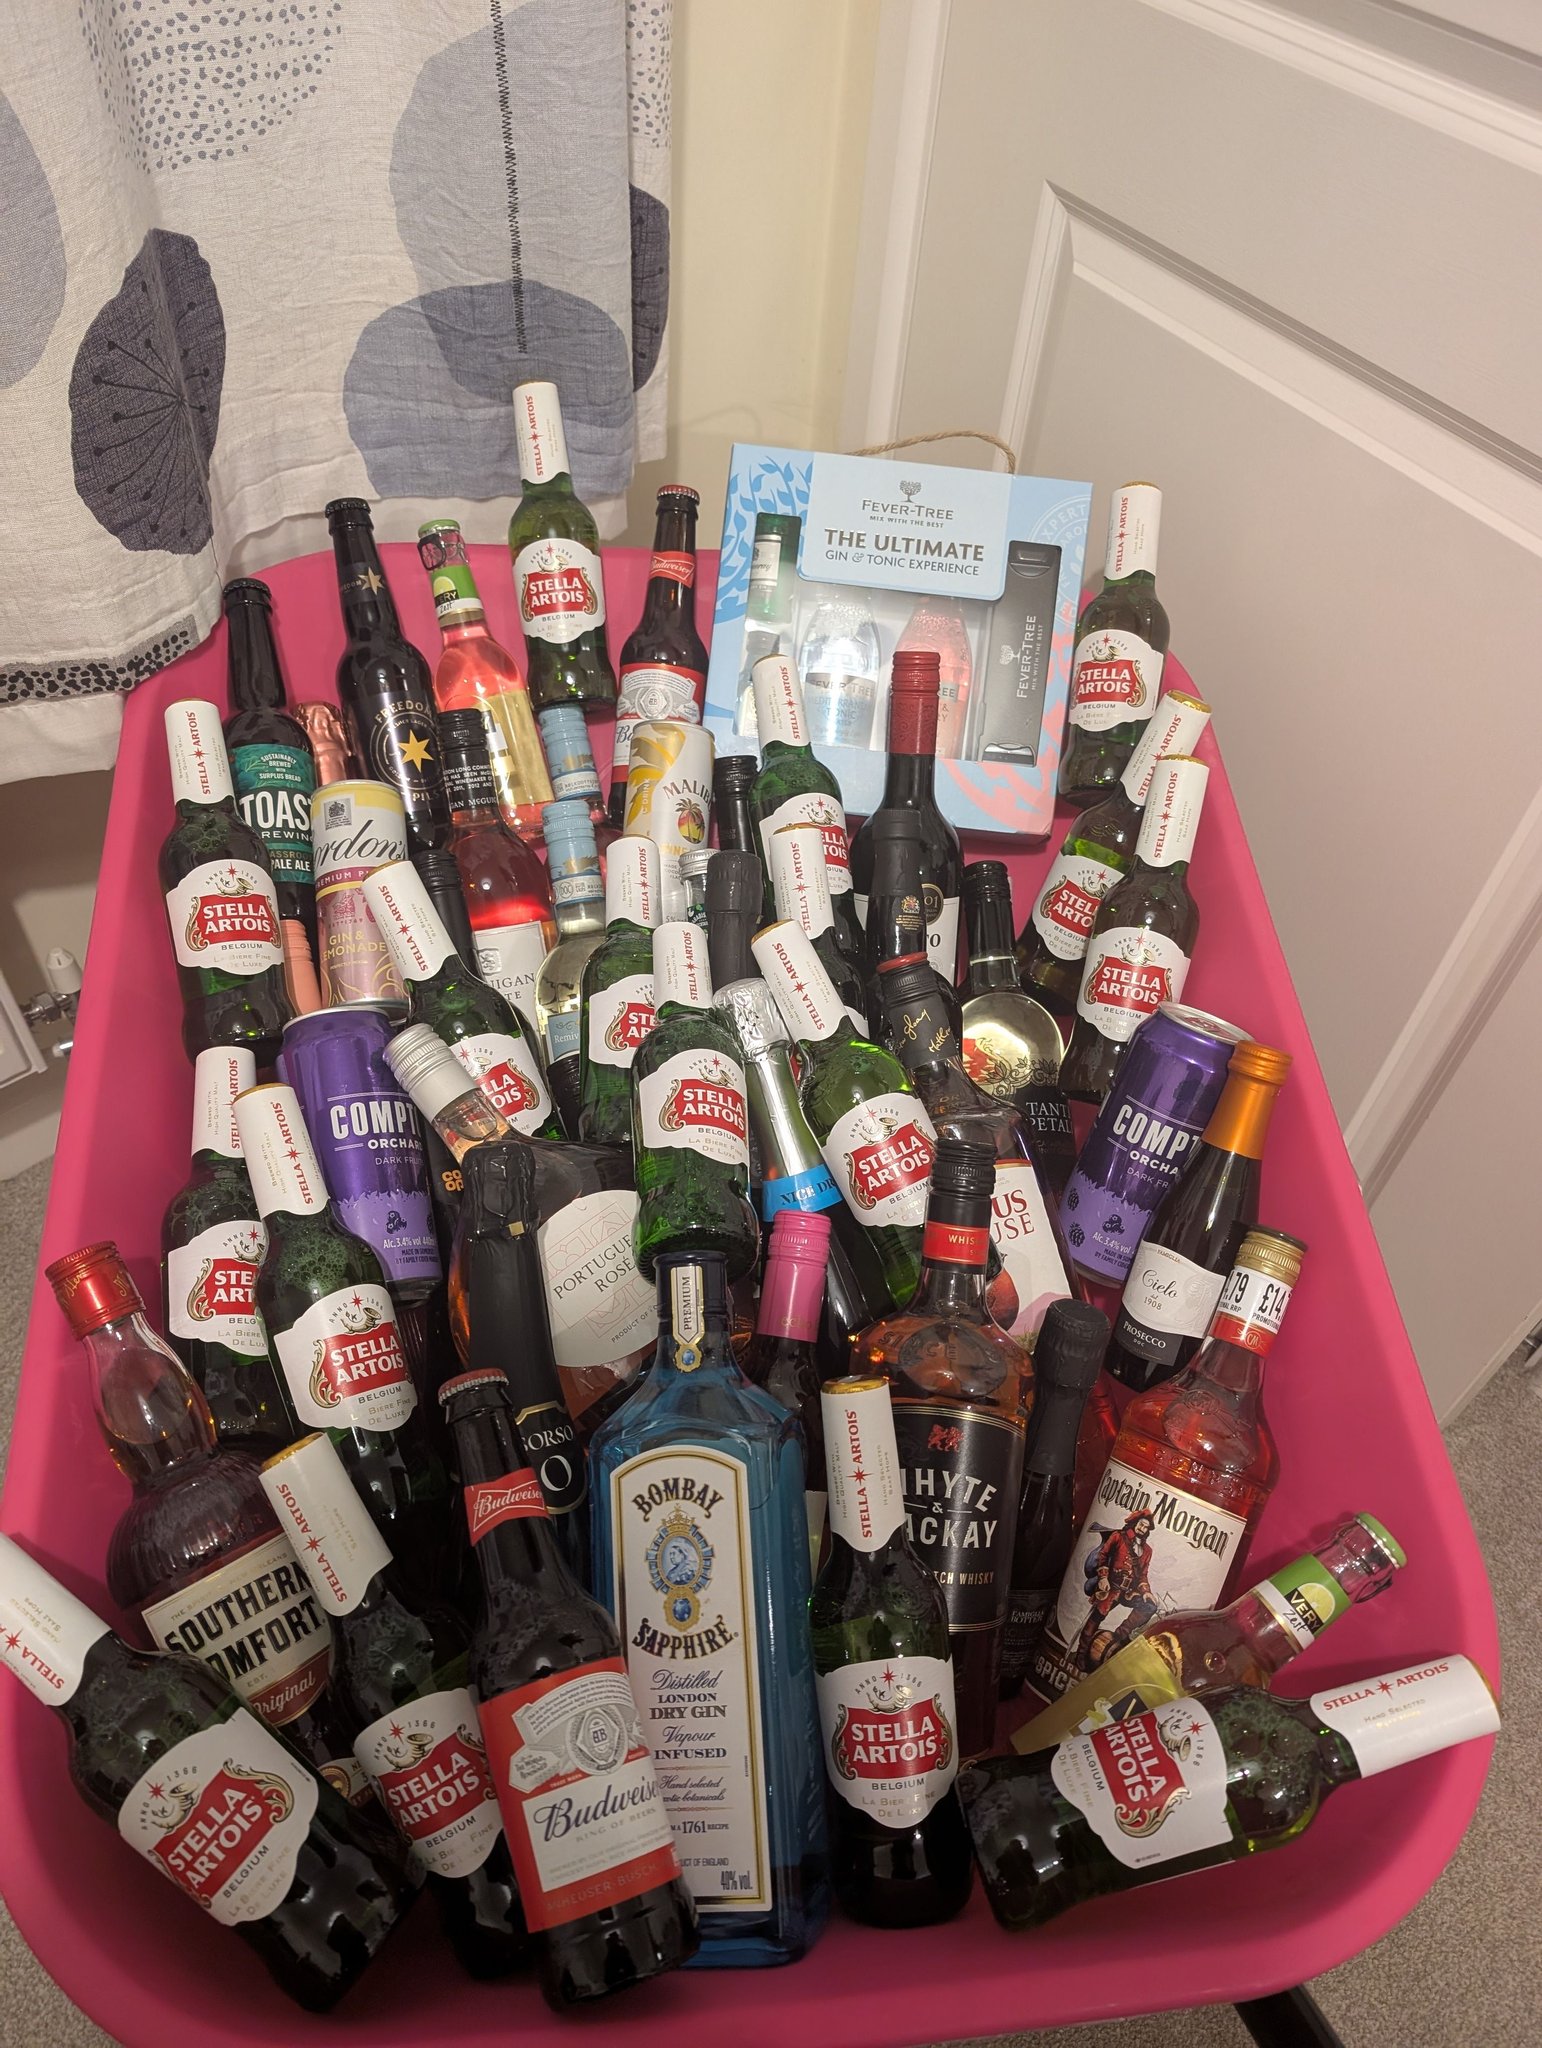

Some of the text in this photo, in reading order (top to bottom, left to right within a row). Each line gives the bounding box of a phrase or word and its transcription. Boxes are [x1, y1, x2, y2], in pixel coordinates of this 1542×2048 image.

[526, 395, 544, 476] STELLA ARTOIS
[862, 499, 954, 521] FEVER-TREE
[887, 518, 907, 526] WITH
[909, 520, 924, 528] THE
[926, 521, 944, 529] BEST
[1115, 497, 1128, 572] STELLA ARTOIS
[824, 528, 985, 562] THE ULTIMATE
[825, 549, 979, 576] GIN & TONIC EXPERIENCE
[529, 578, 582, 595] STELLA
[530, 590, 585, 609] ARTOIS
[541, 613, 576, 622] BELGIUM
[1016, 615, 1037, 698] FEVER-TREE
[1077, 682, 1132, 696] ARTOIS
[1079, 669, 1131, 683] STELLA
[781, 665, 801, 740] STELLA ARTOIS
[1160, 714, 1183, 753] ARTOIS
[189, 710, 211, 796] STELLA ARTOIS
[261, 754, 297, 764] SUSTAINABLY
[268, 760, 292, 768] BREWED
[285, 774, 302, 782] BREAD
[1153, 770, 1179, 859] STELLA ARTOIS
[295, 861, 311, 872] ALE
[640, 847, 651, 921] STELLA ARTOIS
[792, 841, 812, 932] STELLA ARTOIS
[203, 903, 269, 920] STELLA
[196, 917, 272, 934] ARTOIS
[329, 930, 364, 945] GIN &
[379, 883, 428, 972] STELLA ARTOIS
[1053, 924, 1087, 944] BELGIUM
[221, 943, 263, 951] BELGIUM
[682, 930, 699, 1001] STELLA ARTOIS
[1101, 966, 1162, 990] STELLA
[772, 942, 826, 1031] STELLA ARTOIS
[1097, 983, 1161, 1005] ARTOIS
[1103, 1006, 1142, 1020] BELGIUM
[229, 1058, 240, 1097] ARTOIS
[682, 1088, 745, 1113] STELLA
[682, 1102, 745, 1131] ARTOIS
[697, 1127, 739, 1143] BELGIUM
[271, 1101, 314, 1205] STELLA ARTOIS
[375, 1157, 402, 1165] DARK
[858, 1135, 925, 1175] STELLA
[866, 1152, 932, 1192] ARTOIS
[1126, 1167, 1153, 1184] DARK
[888, 1180, 931, 1205] BELGIUM
[383, 1237, 422, 1249] Alc. 3.4% vol
[1103, 1236, 1120, 1251] 3.4%
[1120, 1245, 1131, 1255] vol
[594, 1256, 636, 1293] ROSÉ
[1141, 1269, 1178, 1299] Cielo
[682, 1275, 692, 1332] PREMIUM
[1143, 1297, 1162, 1311] 1908
[1229, 1305, 1242, 1313] RRP
[610, 1309, 651, 1344] PRODUCT OF
[1123, 1321, 1166, 1349] PROSECCO
[330, 1336, 400, 1367] STELLA
[335, 1354, 405, 1386] ARTOIS
[357, 1385, 402, 1406] BELGIUM
[846, 1409, 873, 1539] STELLA ARTOIS
[630, 1476, 725, 1524] BOMBAY
[932, 1502, 944, 1514] &
[1150, 1490, 1231, 1560] Morgan
[276, 1482, 349, 1603] STELLA ARTOIS
[959, 1571, 995, 1585] WHISKY
[1283, 1610, 1308, 1632] Zest
[1290, 1593, 1321, 1628] VERY
[631, 1614, 734, 1661] SAPPHIRE
[21, 1646, 65, 1689] STELLA
[650, 1669, 724, 1691] Distilled
[854, 1674, 878, 1695] ANNO
[1323, 1662, 1450, 1711] STELLA ARTOIS
[657, 1692, 718, 1704] LONDON
[649, 1705, 728, 1721] DRY GIN
[662, 1726, 716, 1748] Vapour
[850, 1717, 937, 1743] STELLA
[654, 1747, 727, 1760] INFUSED
[852, 1737, 939, 1765] ARTOIS
[1123, 1717, 1168, 1797] STELLA
[1081, 1744, 1105, 1791] BELGIUM
[1103, 1725, 1147, 1804] ARTOIS
[388, 1751, 470, 1806] STELLA
[659, 1775, 723, 1789] Hand selected
[871, 1778, 925, 1791] BELGIUM
[399, 1769, 480, 1827] ARTOIS
[681, 1788, 726, 1802] botanicals
[167, 1788, 246, 1872] STELLA
[426, 1815, 477, 1848] BELGIUM
[576, 1807, 657, 1843] KING OF BEERS
[682, 1821, 707, 1834] 1761
[185, 1800, 262, 1889] ARTOIS
[222, 1845, 270, 1898] BELGIUM
[693, 1858, 728, 1867] OF ENGLAND
[720, 1870, 752, 1890] 40% vol.
